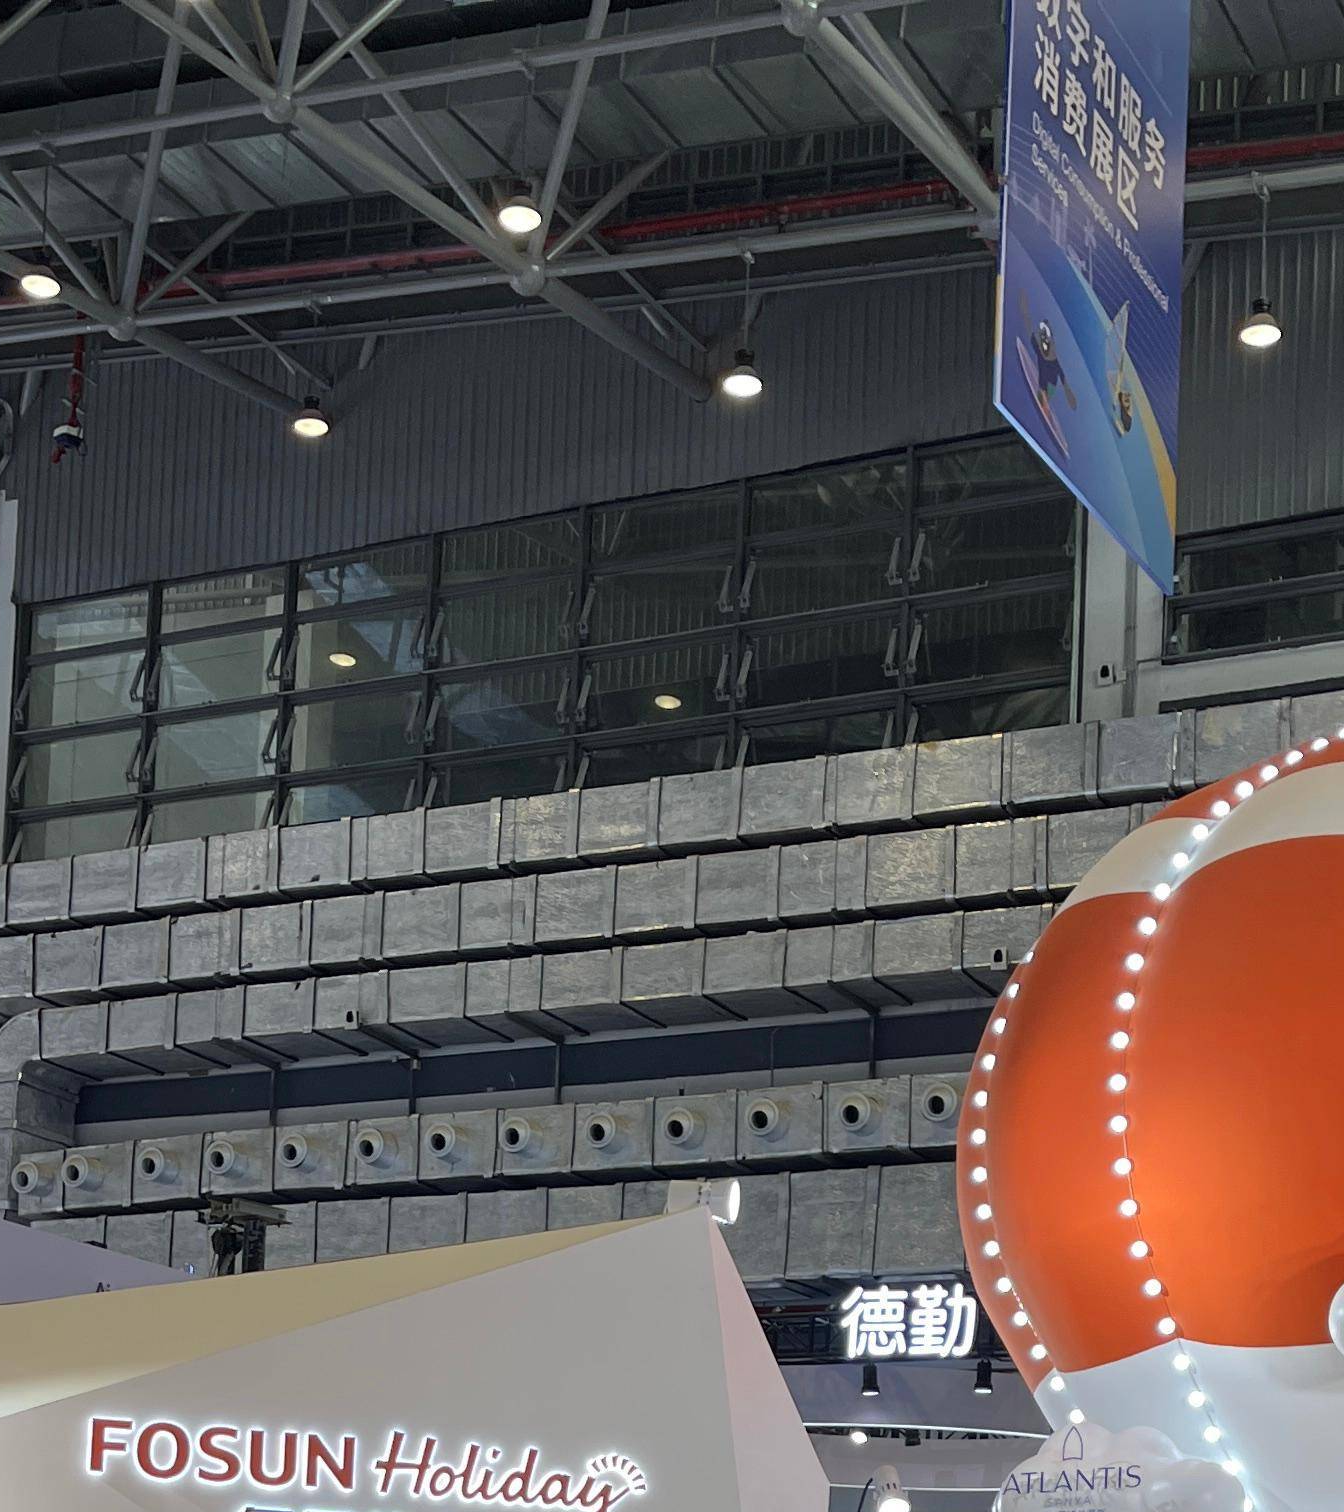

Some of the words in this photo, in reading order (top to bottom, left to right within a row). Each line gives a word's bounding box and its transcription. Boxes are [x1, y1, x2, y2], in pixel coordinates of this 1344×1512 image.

[1033, 23, 1139, 232] 消费展区
[841, 1283, 977, 1359] 德勤
[88, 1417, 356, 1492] FOSUN
[1002, 1465, 1143, 1496] ATLANTIS
